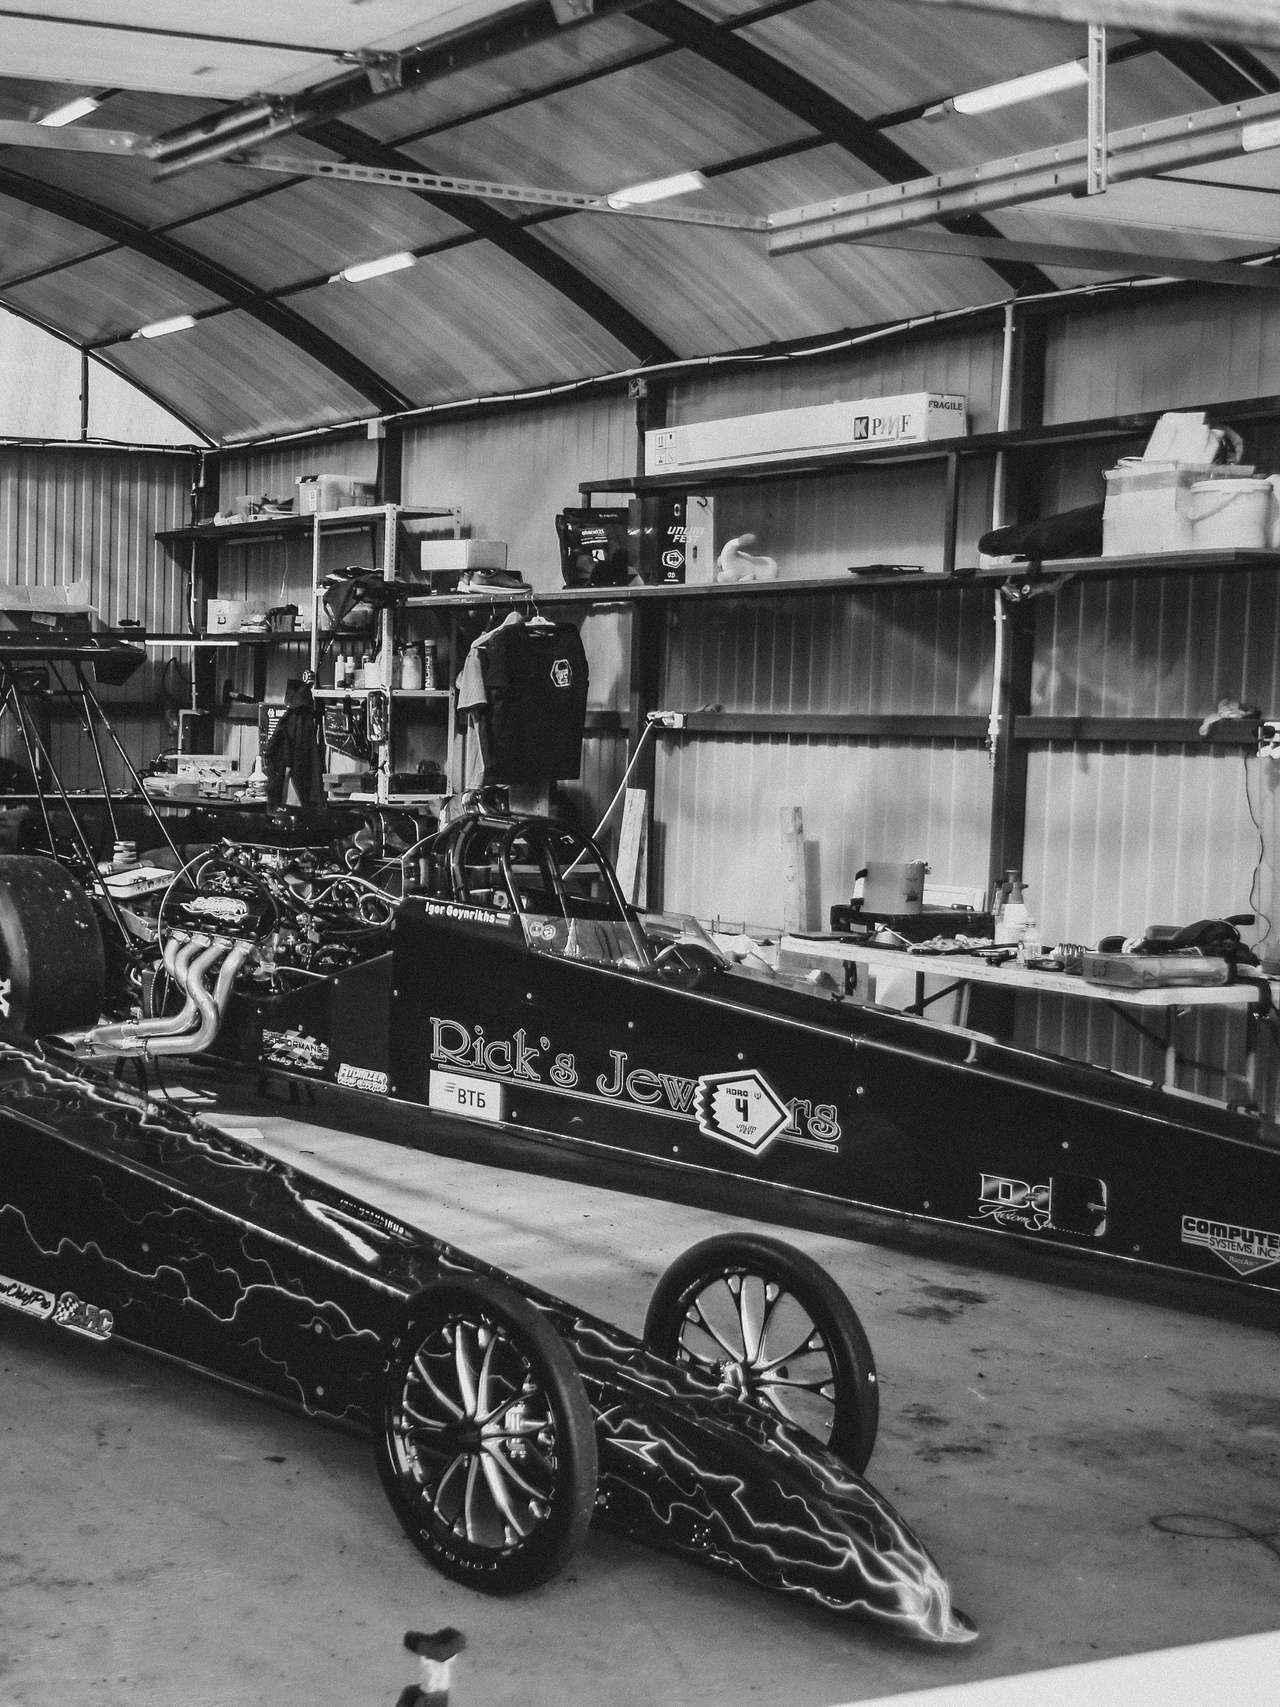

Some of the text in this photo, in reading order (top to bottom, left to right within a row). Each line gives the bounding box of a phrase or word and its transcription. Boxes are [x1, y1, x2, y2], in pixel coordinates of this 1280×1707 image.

[928, 400, 963, 411] FRAGILE
[672, 535, 701, 543] FEST
[425, 901, 445, 916] Igor
[430, 1016, 842, 1142] Rick's Jewrs
[458, 1088, 486, 1109] ВТБ
[735, 1098, 749, 1122] 4
